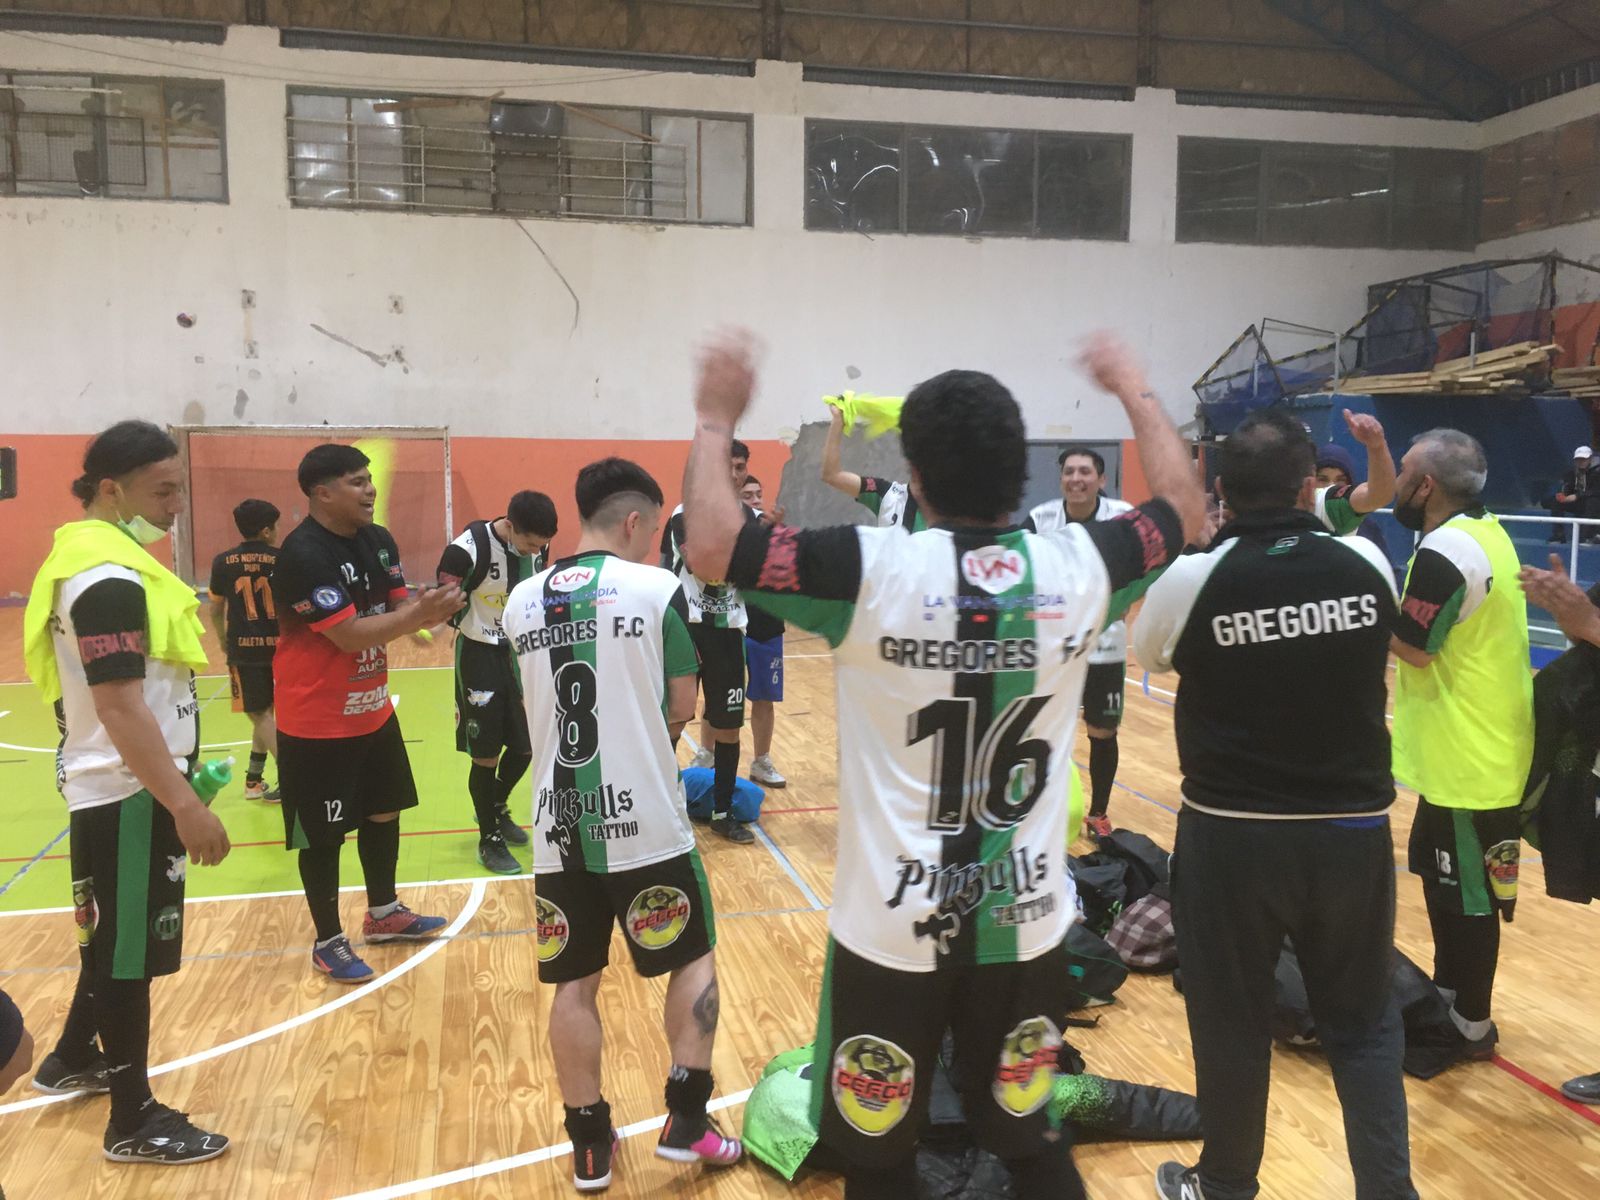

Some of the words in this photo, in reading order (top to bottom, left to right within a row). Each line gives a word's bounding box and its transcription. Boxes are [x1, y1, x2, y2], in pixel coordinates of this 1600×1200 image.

[225, 556, 239, 564] LOS
[340, 562, 358, 585] 12
[490, 562, 500, 580] 5
[552, 571, 591, 586] LVN
[234, 575, 276, 621] 11
[525, 601, 537, 611] LA
[923, 594, 945, 608] LA
[612, 616, 645, 638] F.C
[1211, 593, 1379, 647] GREGORES
[879, 636, 1038, 672] GREGORES
[772, 671, 778, 684] 6
[343, 698, 387, 715] DEPOR
[727, 688, 743, 705] 20
[1107, 691, 1120, 709] 11
[553, 660, 599, 768] 8
[906, 694, 1055, 836] 16
[324, 799, 343, 822] 12
[535, 784, 634, 827] PitBulls
[588, 821, 639, 841] TATTOO
